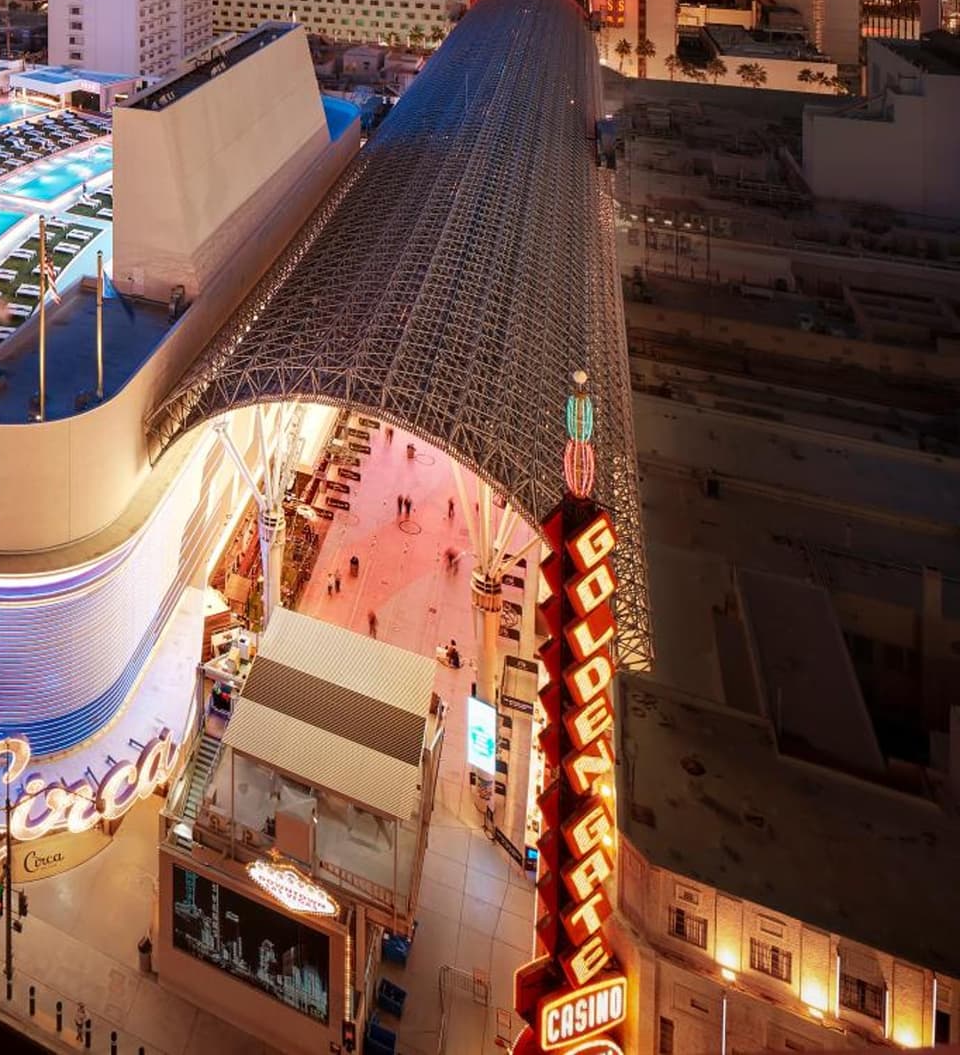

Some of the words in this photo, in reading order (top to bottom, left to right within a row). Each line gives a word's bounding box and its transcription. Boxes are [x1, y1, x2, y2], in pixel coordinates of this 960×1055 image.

[572, 518, 615, 790] GOLDEN
[24, 850, 64, 873] Circa
[570, 805, 612, 985] GATE
[547, 985, 622, 1043] CASINO
